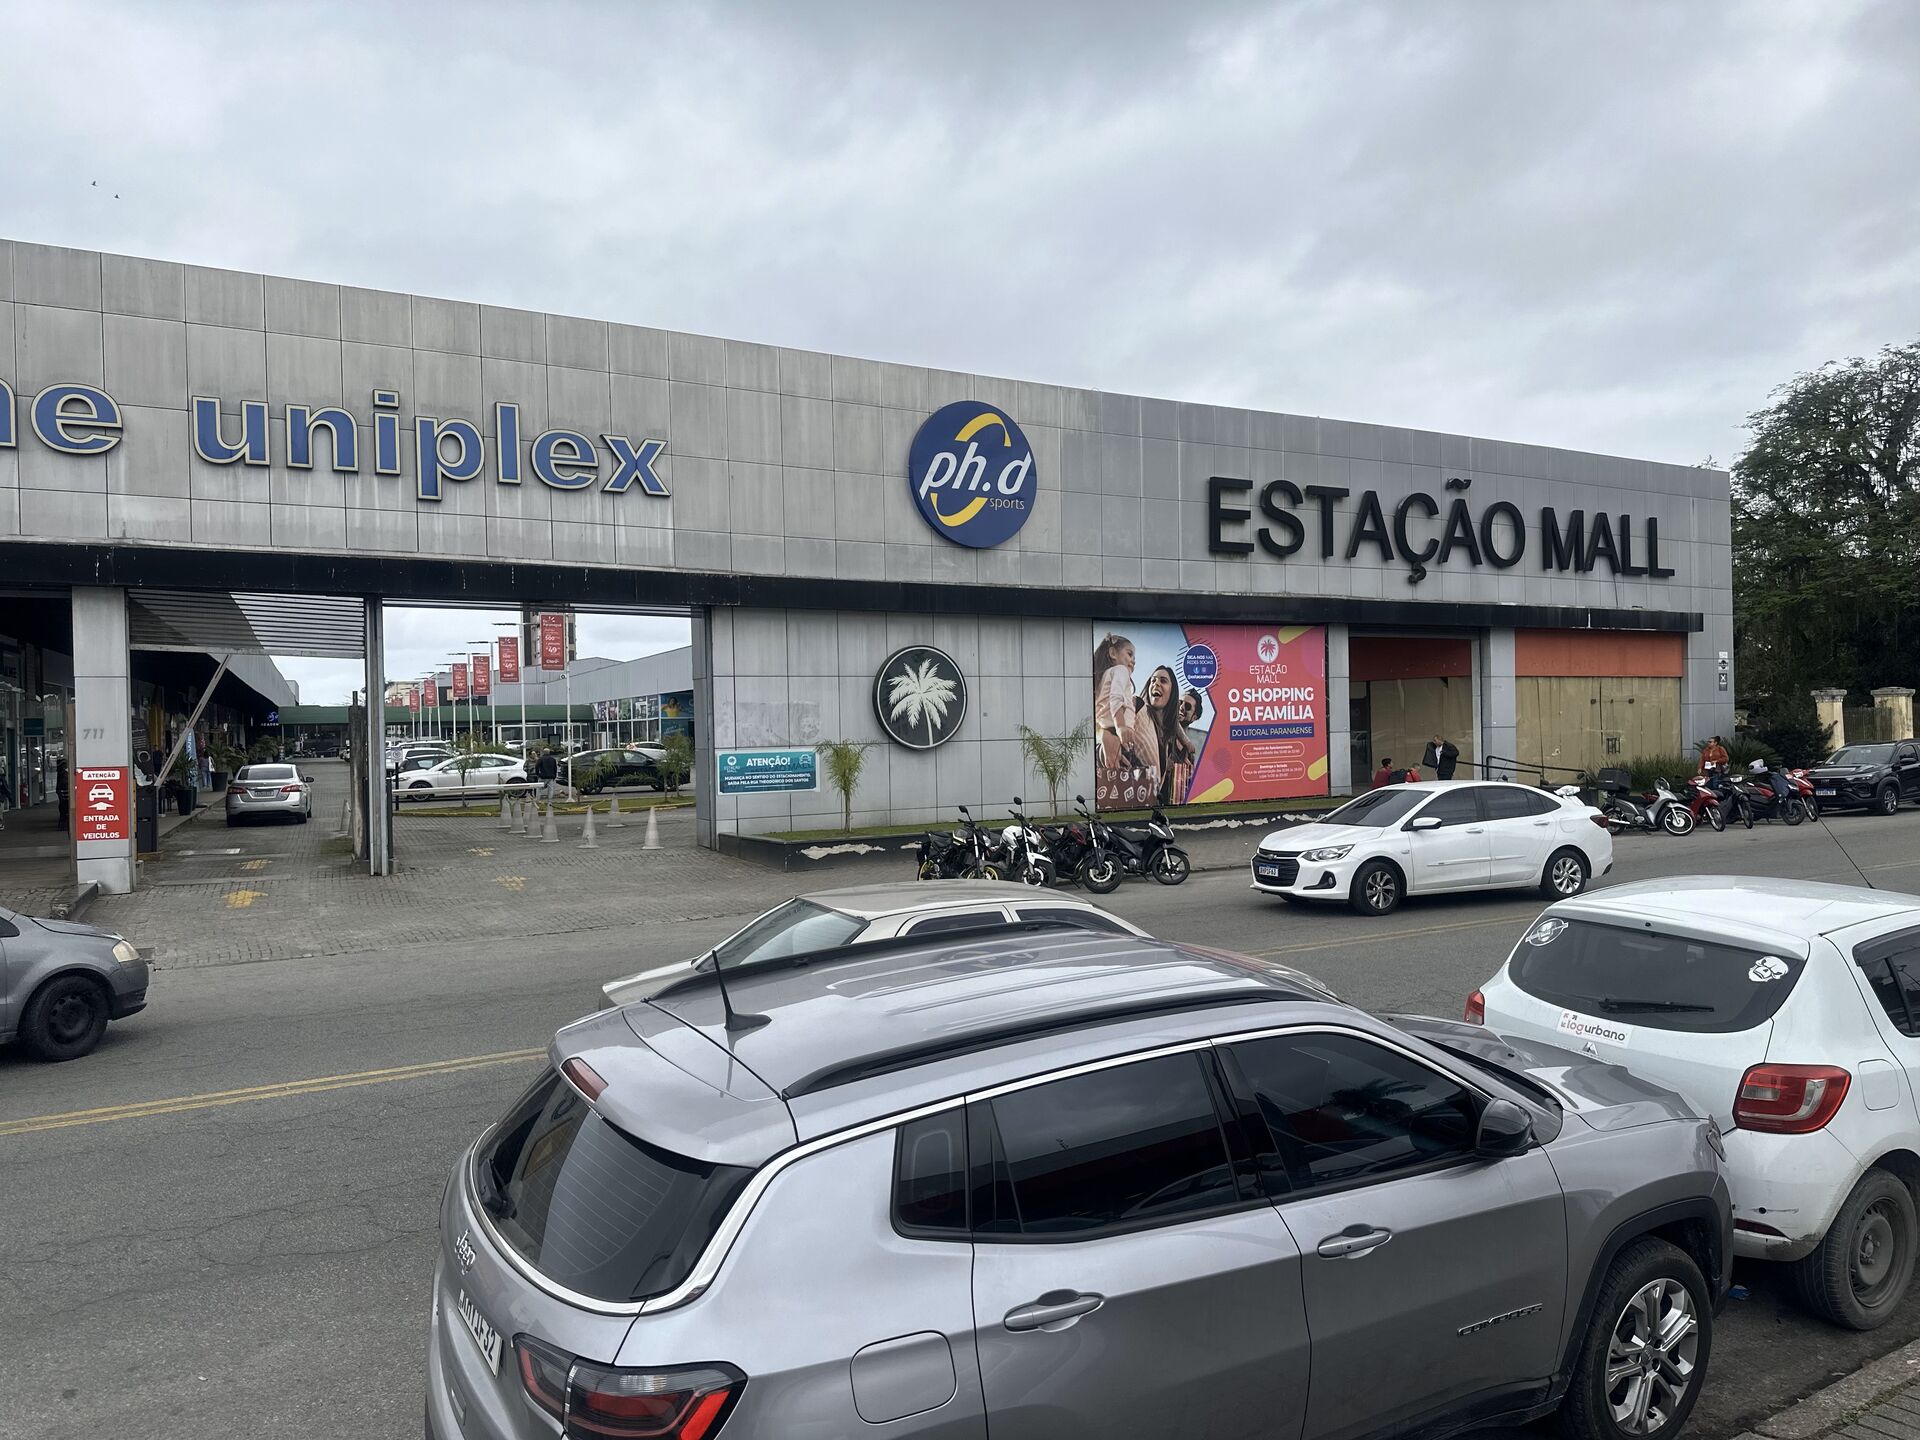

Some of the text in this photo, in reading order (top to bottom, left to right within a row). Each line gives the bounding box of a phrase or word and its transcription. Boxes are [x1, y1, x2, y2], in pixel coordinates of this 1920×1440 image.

[192, 389, 671, 500] uniplex
[919, 442, 1032, 500] ph.d
[990, 497, 1025, 511] sports
[1209, 476, 1675, 584] ESTAÇÃO MALL
[1250, 664, 1288, 674] ESTAÇÃO
[1256, 674, 1281, 684] MALL
[1228, 687, 1314, 703] O SHOPPING
[1229, 702, 1314, 722] DA FAMÍLIA
[83, 728, 104, 740] 711
[1243, 728, 1269, 737] LITORAL
[1270, 726, 1312, 736] PARANAENSE
[746, 756, 790, 767] ATENÇÃO!
[87, 771, 116, 780] ATENÇÃO
[1566, 1019, 1626, 1041] logurbano
[454, 1228, 477, 1276] Jeep
[1457, 1302, 1544, 1337] COMPASS
